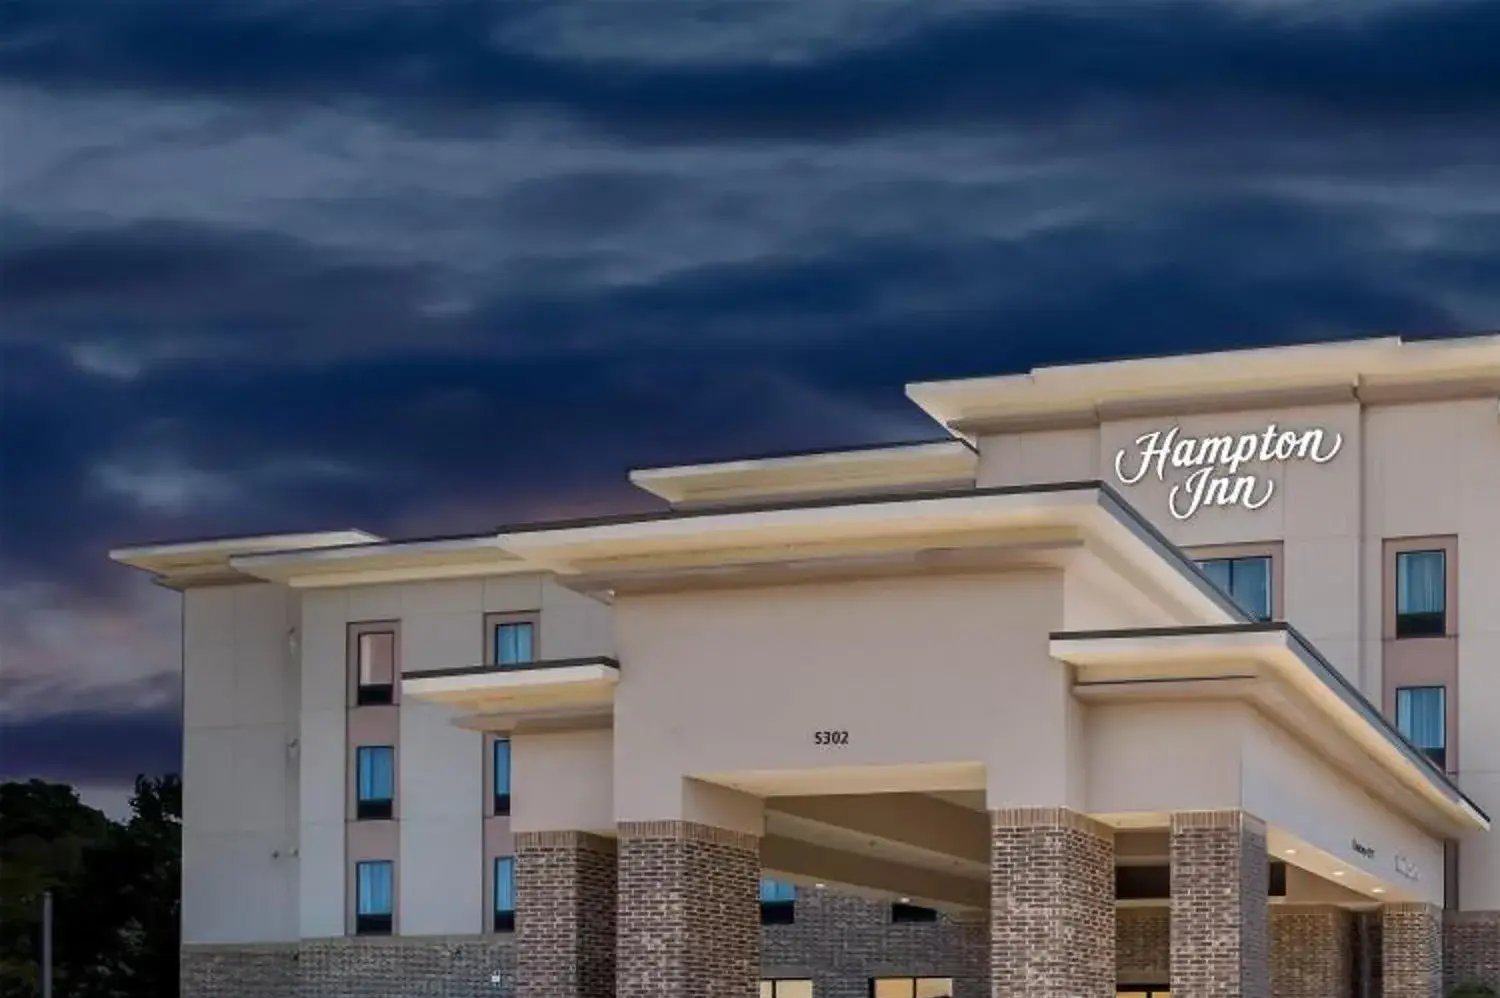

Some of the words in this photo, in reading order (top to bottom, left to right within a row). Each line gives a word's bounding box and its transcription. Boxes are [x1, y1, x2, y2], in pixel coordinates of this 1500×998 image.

[1115, 424, 1343, 484] Hampton
[1169, 466, 1273, 519] Inn
[815, 731, 849, 745] 5302
